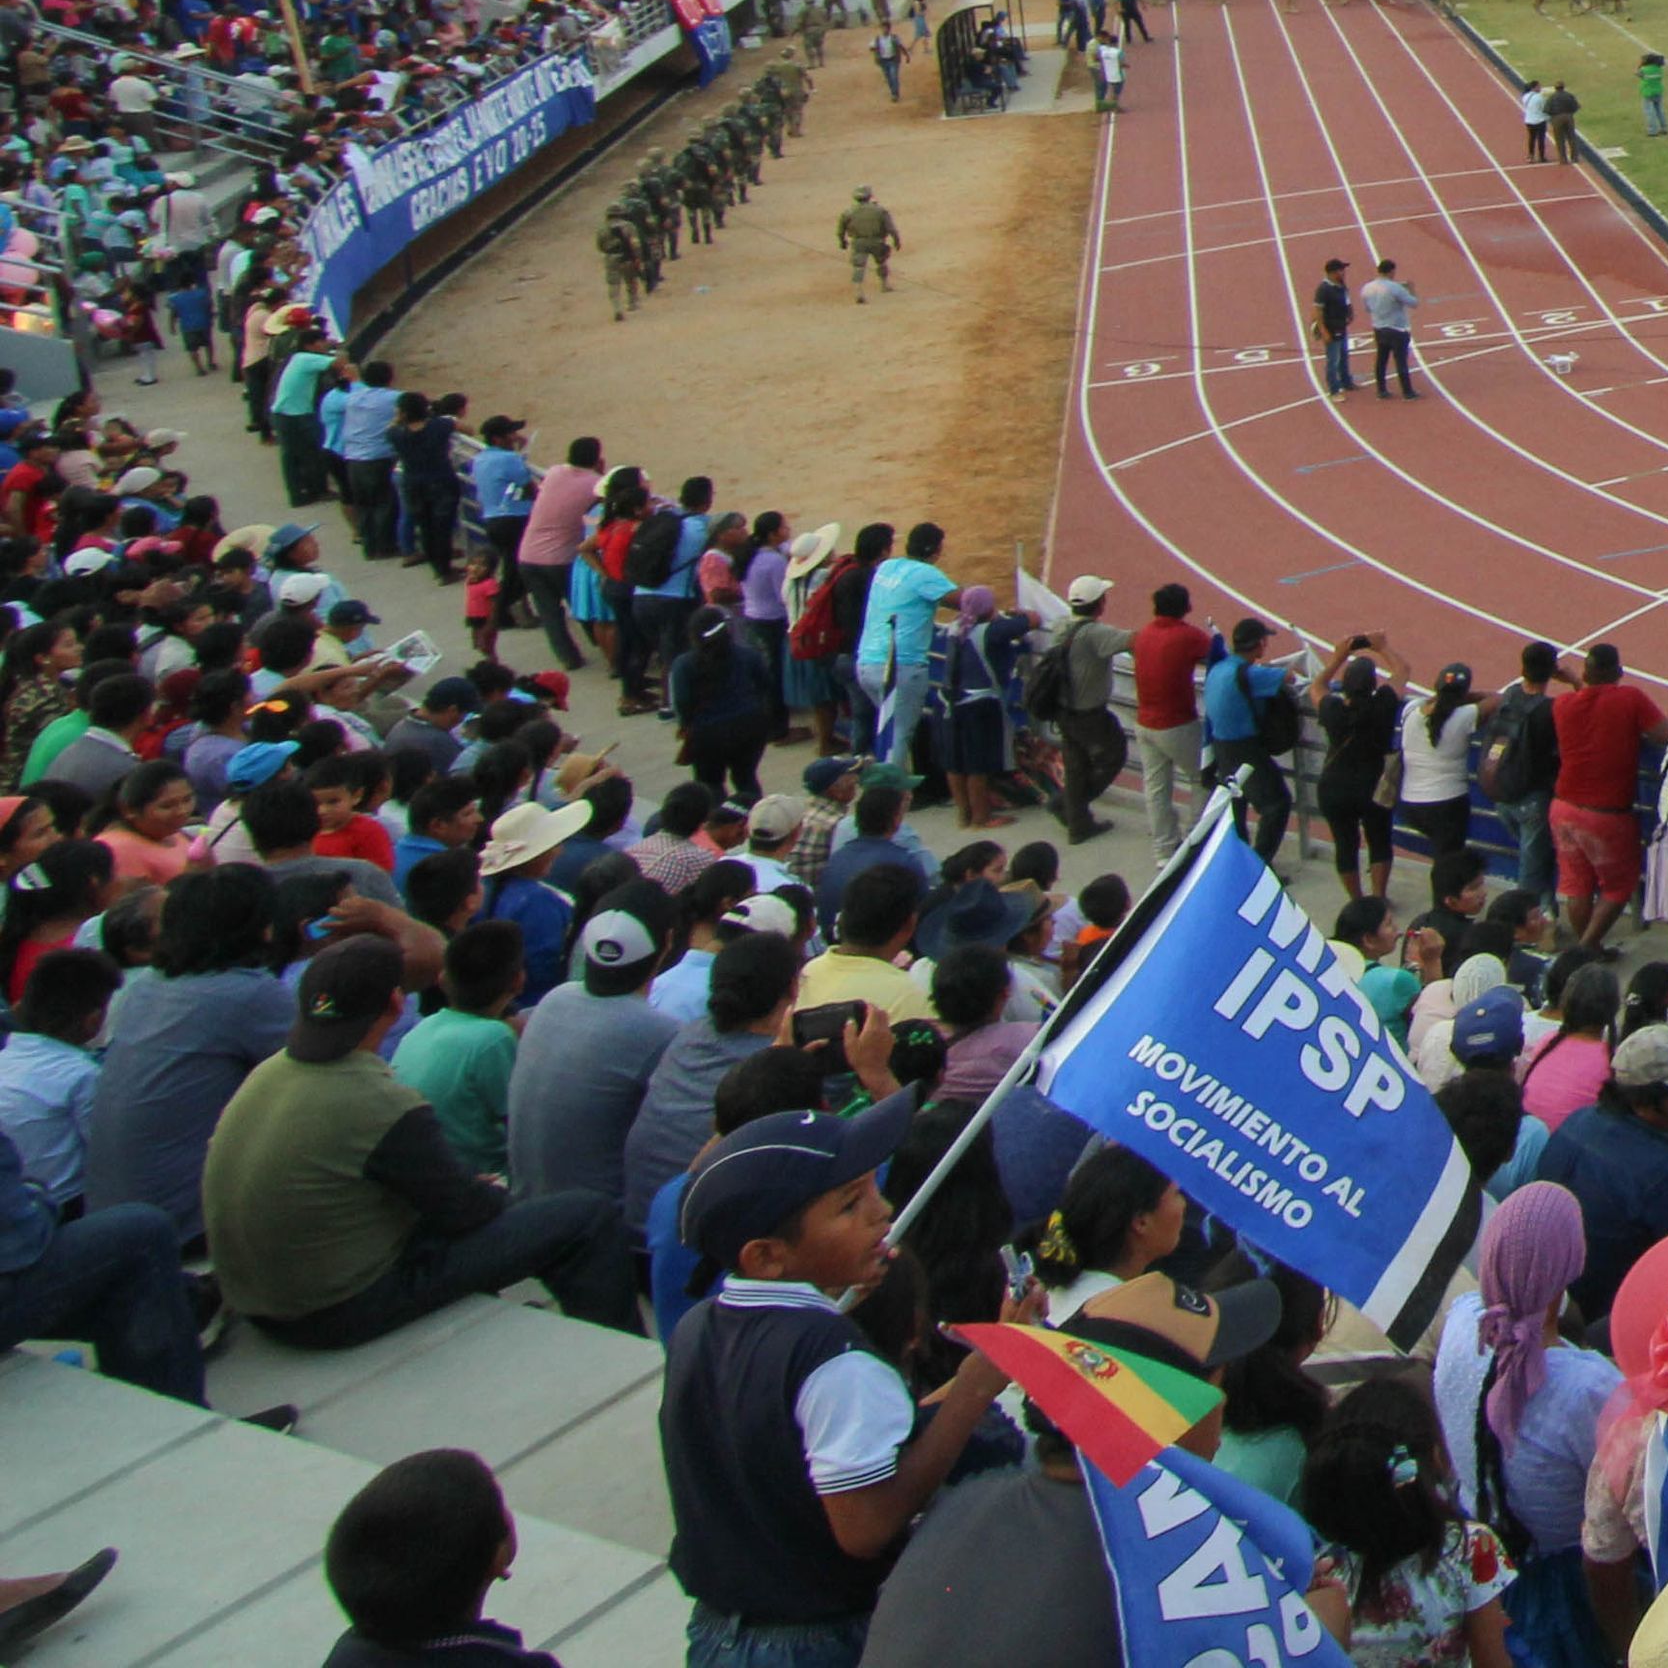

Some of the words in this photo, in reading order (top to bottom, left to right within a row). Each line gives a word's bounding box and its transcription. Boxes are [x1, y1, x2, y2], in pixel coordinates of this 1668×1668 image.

[1213, 946, 1405, 1119] IPSP
[1125, 1089, 1313, 1231] SOCIALISMO
[1127, 1034, 1329, 1183] MOVIMIENTO
[1323, 1174, 1367, 1218] AL
